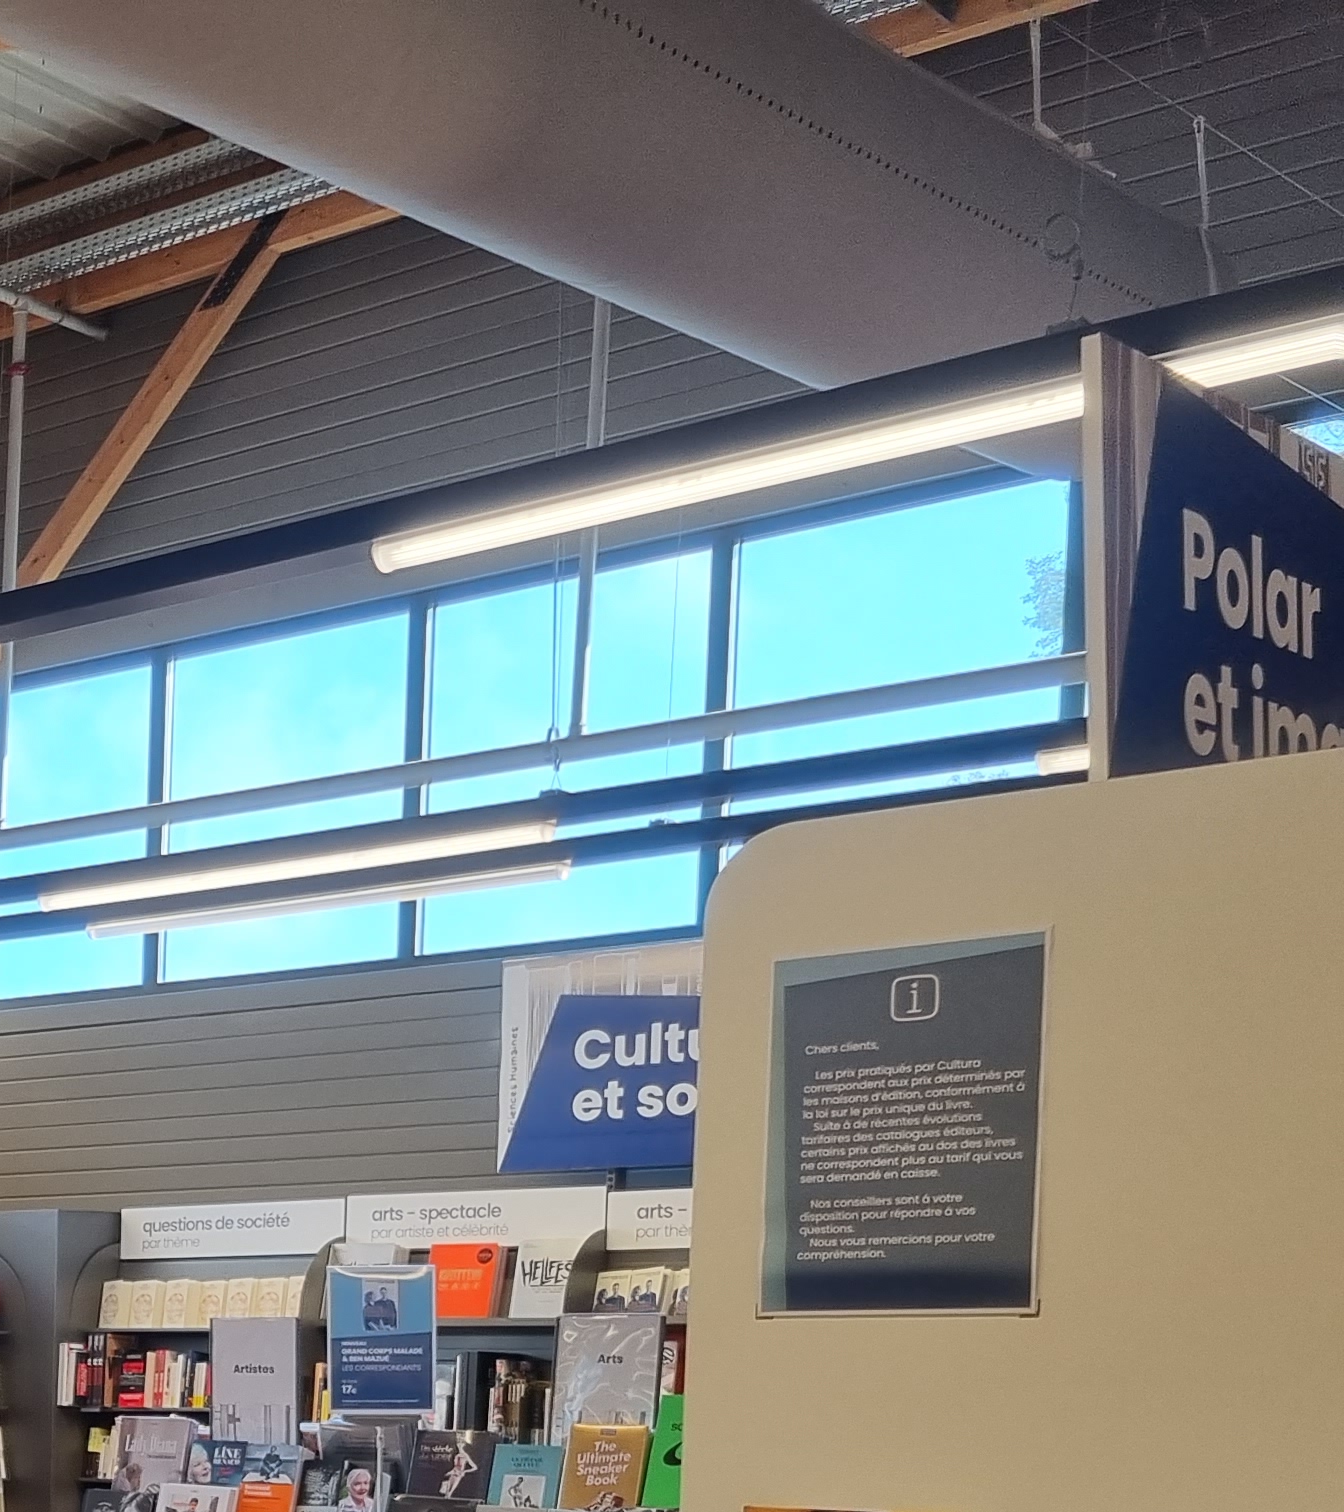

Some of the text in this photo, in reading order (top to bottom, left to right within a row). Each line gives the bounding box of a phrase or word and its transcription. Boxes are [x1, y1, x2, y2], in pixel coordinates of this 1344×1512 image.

[1182, 507, 1322, 659] Polar
[1183, 665, 1239, 762] et
[805, 1044, 838, 1055] Chers
[815, 1059, 981, 1081] Les prix pratiqués par Cultura
[572, 1080, 624, 1122] et
[372, 1203, 501, 1224] arts spectacle
[142, 1212, 291, 1237] questions de société
[371, 1229, 391, 1242] par
[395, 1227, 434, 1238] artiste
[437, 1226, 449, 1237] et
[809, 1233, 995, 1248] Nous vous remercions pour votre
[597, 1353, 623, 1366] Arts
[594, 1440, 617, 1454] The
[575, 1449, 632, 1465] Ultimate
[575, 1462, 627, 1476] Sneaker
[585, 1473, 618, 1487] Book
